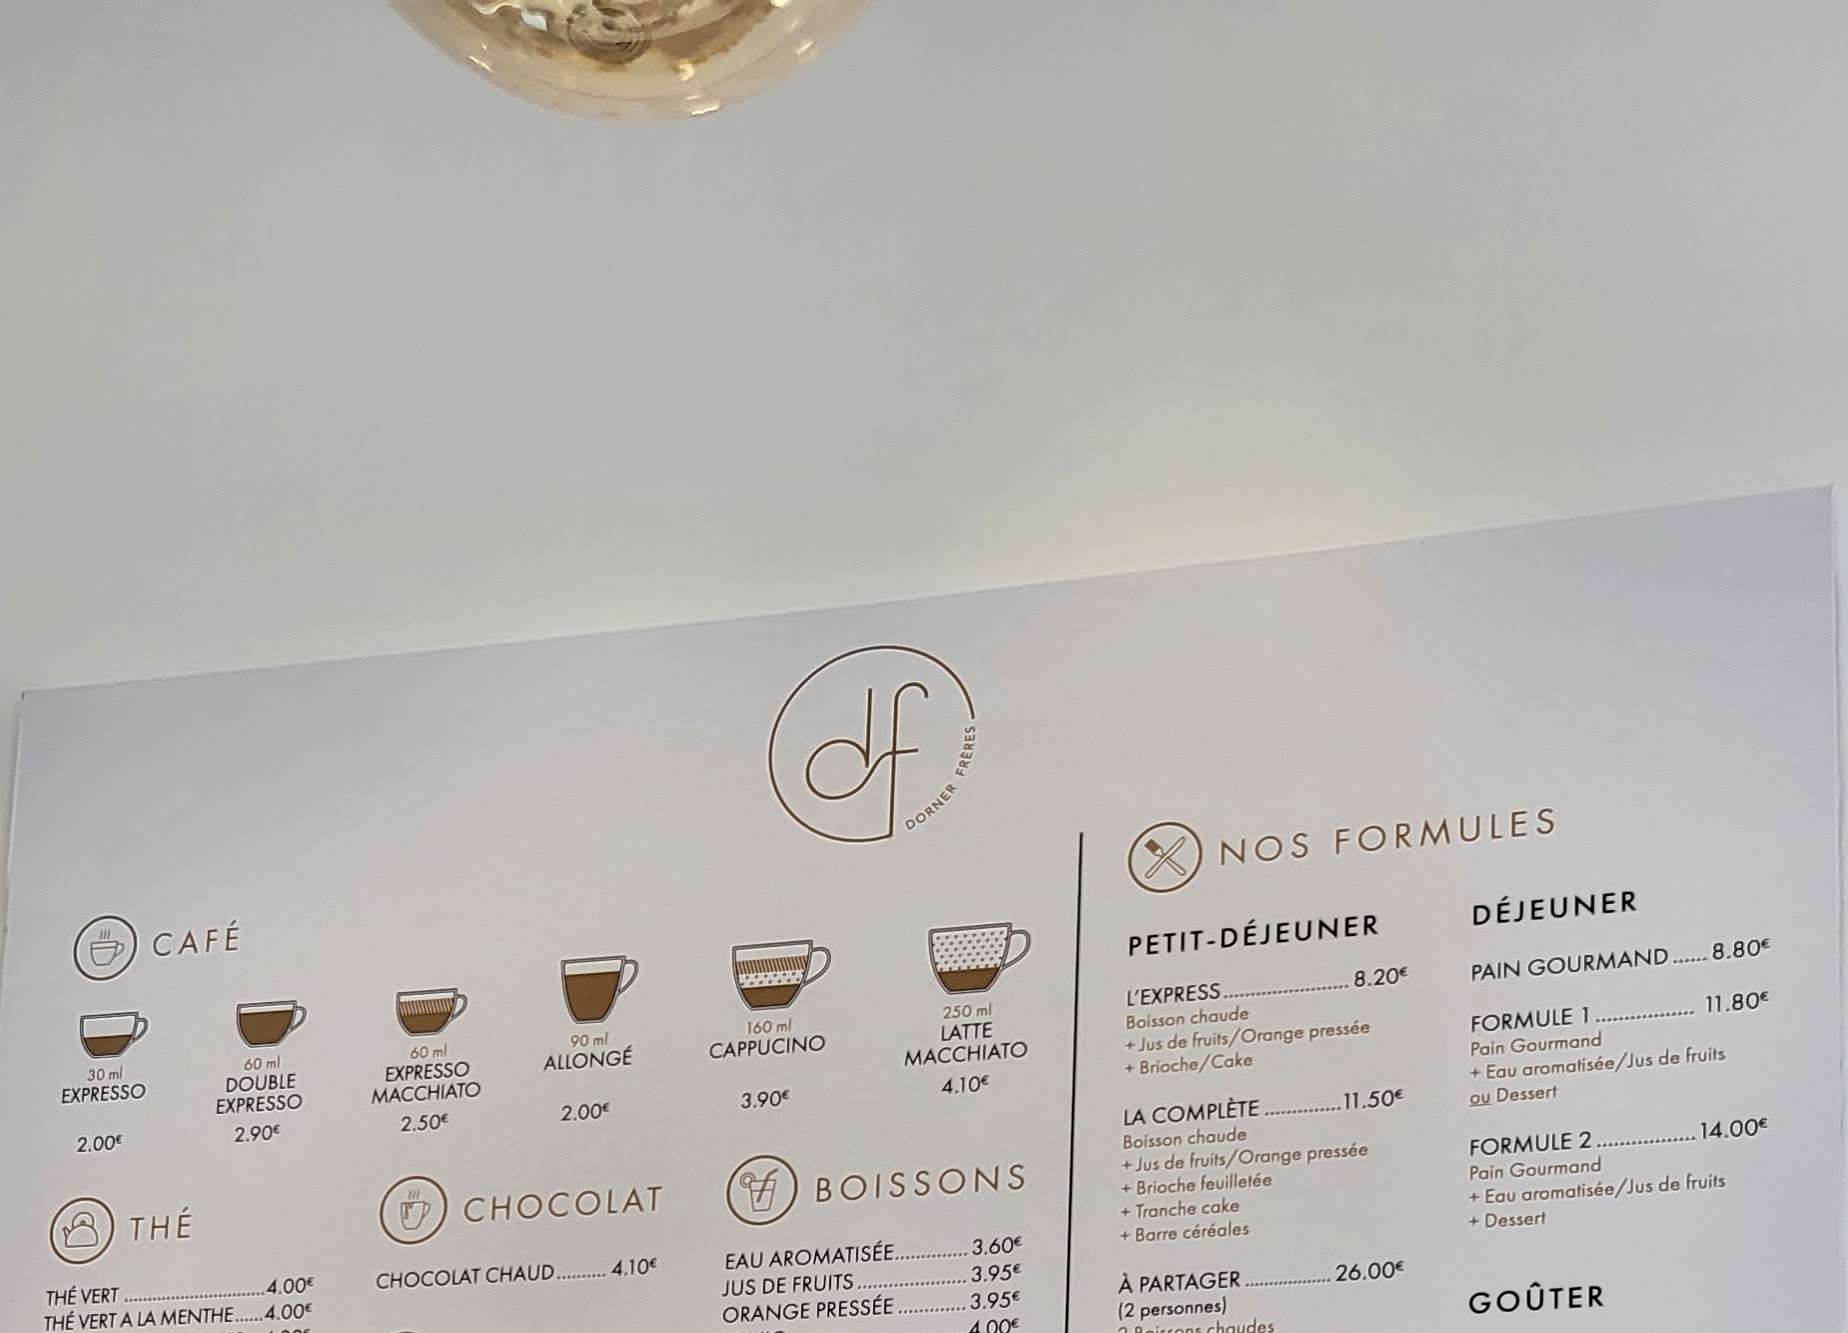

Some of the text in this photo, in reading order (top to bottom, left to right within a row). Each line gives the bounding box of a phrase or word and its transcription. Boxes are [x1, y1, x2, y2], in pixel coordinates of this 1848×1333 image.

[904, 726, 976, 830] DORNER FRÈRES
[1220, 808, 1555, 866] NOS FORMULES
[1472, 890, 1638, 927] DÉJEUNER
[152, 919, 240, 957] CAFÉ
[1128, 914, 1379, 957] PETIT-DÉJEUNER
[1471, 937, 1771, 982] PAIN GOURMAND 8.80€
[1353, 966, 1409, 988] 8.20€
[942, 1001, 992, 1020] 250 ml
[1126, 1004, 1250, 1030] Boisson chaude
[1471, 990, 1770, 1034] FORMULE 1 11.80€
[570, 1031, 609, 1048] 90 ml
[747, 1017, 792, 1035] 160 ml
[940, 1021, 993, 1042] LATTE
[1137, 1036, 1164, 1052] Jus
[1166, 1033, 1188, 1050] de
[1192, 1027, 1305, 1049] fruits/Orange
[1309, 1019, 1371, 1043] pressée
[409, 1043, 448, 1060] 60 ml
[709, 1034, 826, 1060] CAPPUCINO
[904, 1041, 1028, 1067] MACCHIATO
[1470, 1029, 1602, 1057] Pain Gourmand
[243, 1054, 281, 1072] 60 ml
[384, 1060, 471, 1083] EXPRESSO
[542, 1045, 633, 1072] ALLONGÉ
[1486, 1063, 1518, 1080] Eau
[1521, 1051, 1654, 1077] aromatisée/Jus
[1657, 1047, 1681, 1066] de
[1685, 1045, 1726, 1064] fruits
[86, 1064, 124, 1082] 30 ml
[225, 1072, 297, 1094] DOUBLE
[940, 1074, 990, 1095] 4.10€
[61, 1083, 147, 1105] EXPRESSO
[215, 1093, 303, 1115] EXPRESSO
[371, 1081, 482, 1105] MACCHIATO
[740, 1089, 790, 1110] 3.90€
[1469, 1085, 1558, 1108] ou Dessert
[560, 1101, 611, 1122] 2.00€
[1123, 1088, 1404, 1127] LA COMPLÈTE 11.50€
[233, 1123, 281, 1143] 2.90€
[400, 1112, 449, 1133] 2.50€
[76, 1133, 123, 1153] 2.00€
[1469, 1117, 1769, 1157] FORMULE 2 14.00€
[815, 1163, 1025, 1203] BOISSONS
[1136, 1175, 1197, 1196] Brioche
[1200, 1172, 1273, 1192] feuilletée
[463, 1186, 663, 1223] CHOCOLAT
[129, 1206, 192, 1242] THÉ
[725, 1235, 1023, 1271] EAU AROMATISÉE 3.60€
[375, 1257, 658, 1290] CHOCOLAT CHAUD 4.10€
[721, 1262, 1022, 1298] JUS DE FRUITS 3.95€
[1117, 1260, 1405, 1295] À PARTAGER 26.00€
[45, 1276, 315, 1307] THÉ VERT 4.00€
[1468, 1281, 1604, 1315] GOÛTER
[43, 1302, 313, 1332] THÉ VERT A LA MENTHE 4.00€
[722, 1290, 1021, 1324] ORANGE PRESSÉE 3.95€
[1118, 1295, 1227, 1322] (2 personnes)
